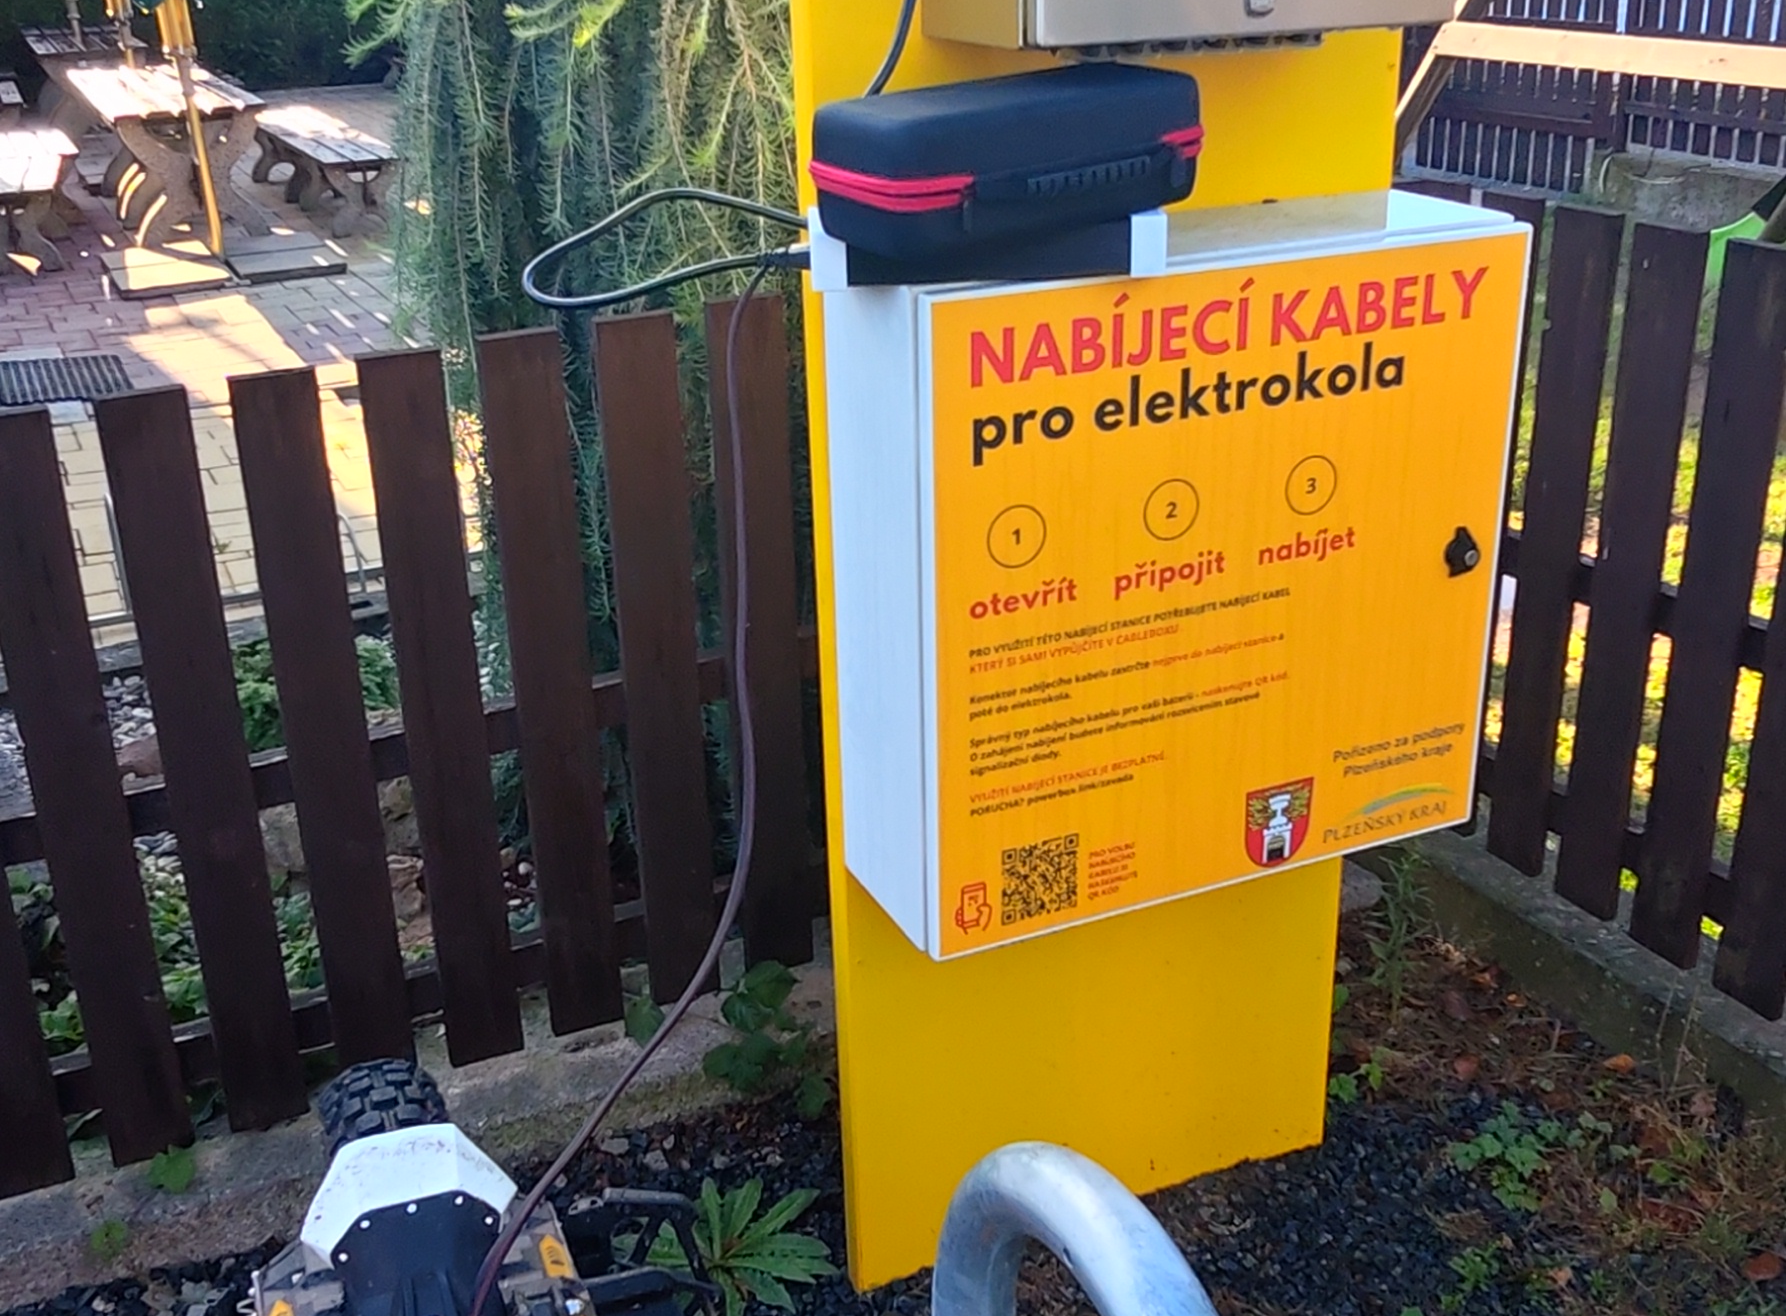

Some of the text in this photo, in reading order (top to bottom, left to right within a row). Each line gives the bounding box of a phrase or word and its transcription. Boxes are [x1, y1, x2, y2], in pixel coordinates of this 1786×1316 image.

[969, 266, 1490, 389] NABÍJECÍ KABELY
[972, 341, 1406, 467] pro elektrokola
[1305, 477, 1317, 495] 3
[1165, 500, 1178, 520] 2
[1011, 527, 1023, 546] 1
[1258, 525, 1357, 566] nabíjet
[1113, 549, 1226, 601] připojit
[969, 577, 1078, 620] otevřít
[968, 646, 991, 659] PRO
[1110, 614, 1151, 632] STANICE
[1262, 587, 1291, 601] KABEL
[969, 687, 1017, 705] Konektor
[1074, 669, 1109, 684] kabelu
[995, 704, 1009, 715] do
[1121, 705, 1139, 717] pro
[1393, 736, 1409, 748] za
[969, 752, 978, 762] O
